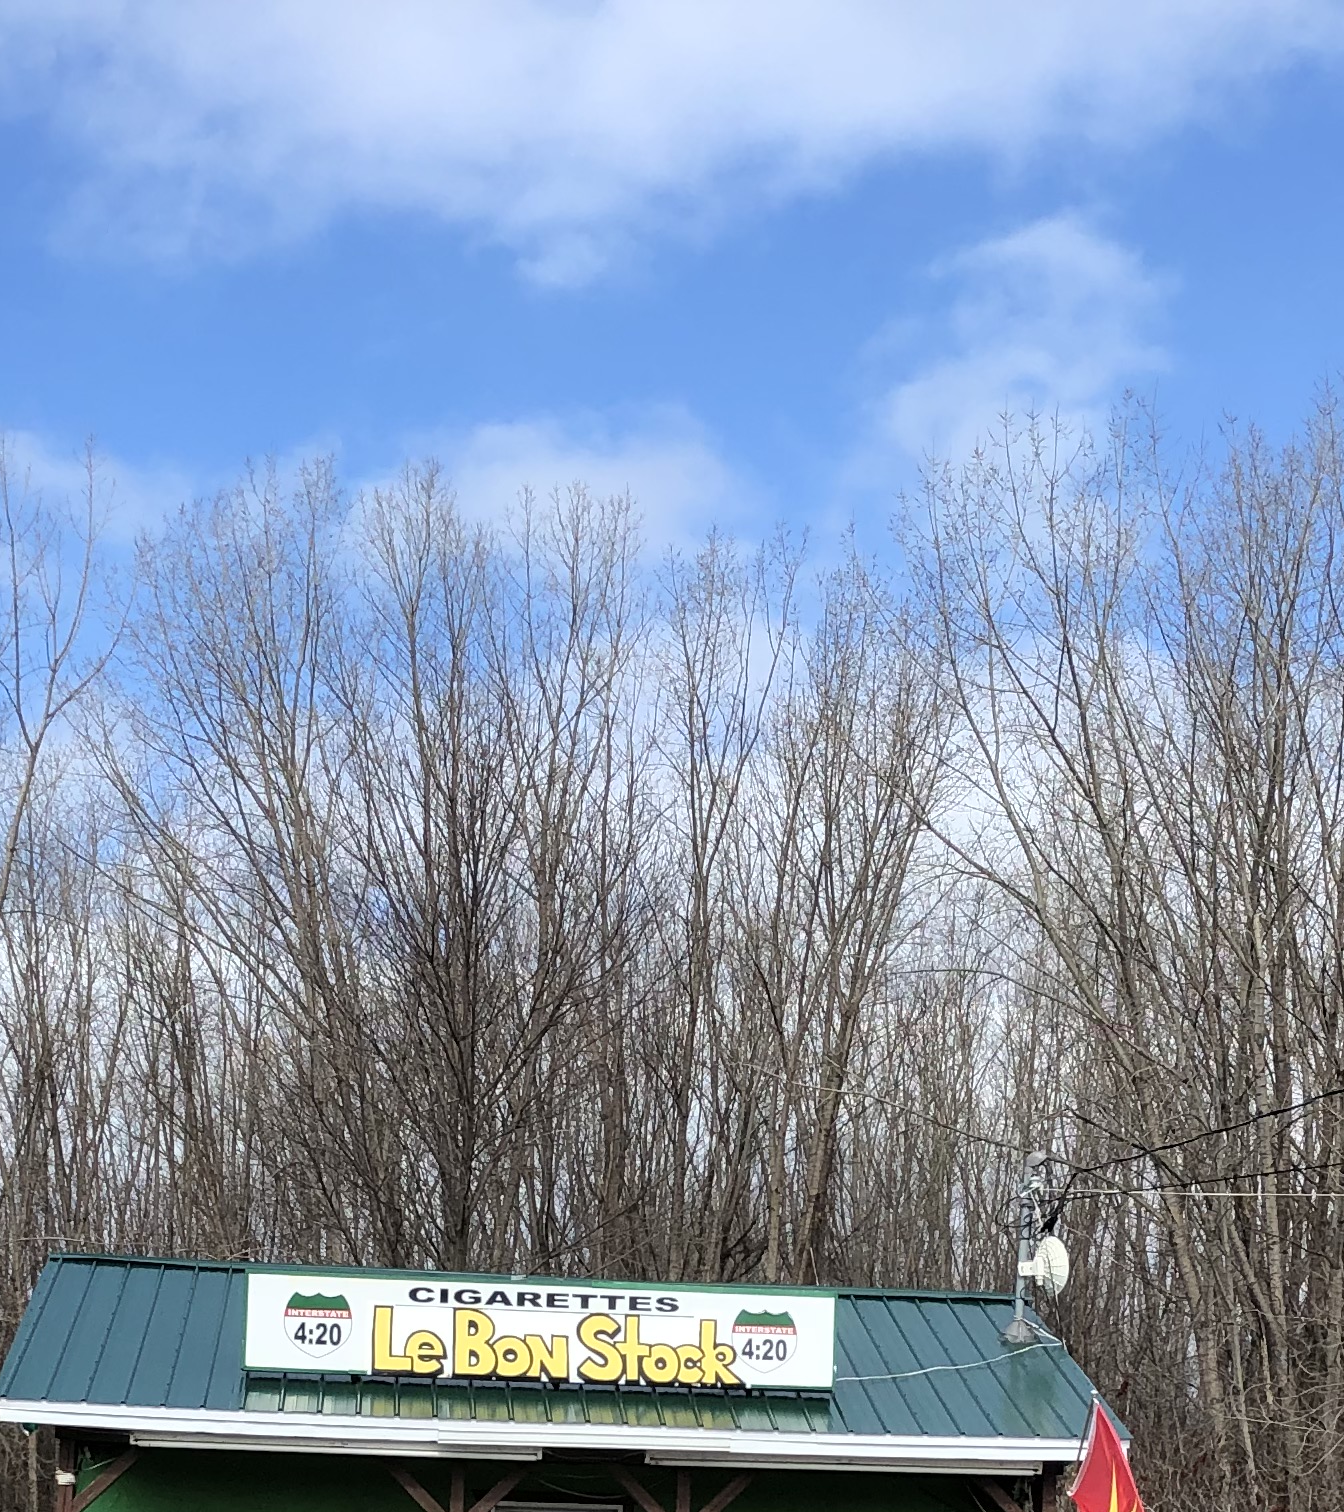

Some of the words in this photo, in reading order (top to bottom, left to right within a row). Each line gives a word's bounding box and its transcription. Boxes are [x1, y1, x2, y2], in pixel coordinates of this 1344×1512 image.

[407, 1287, 680, 1313] CIGARETTES
[287, 1308, 349, 1318] INTERSTATE
[294, 1322, 342, 1346] 4:20
[734, 1325, 794, 1335] INTERSTATE
[372, 1305, 447, 1375] Le
[576, 1312, 747, 1386] Stock
[741, 1338, 787, 1361] 4:20
